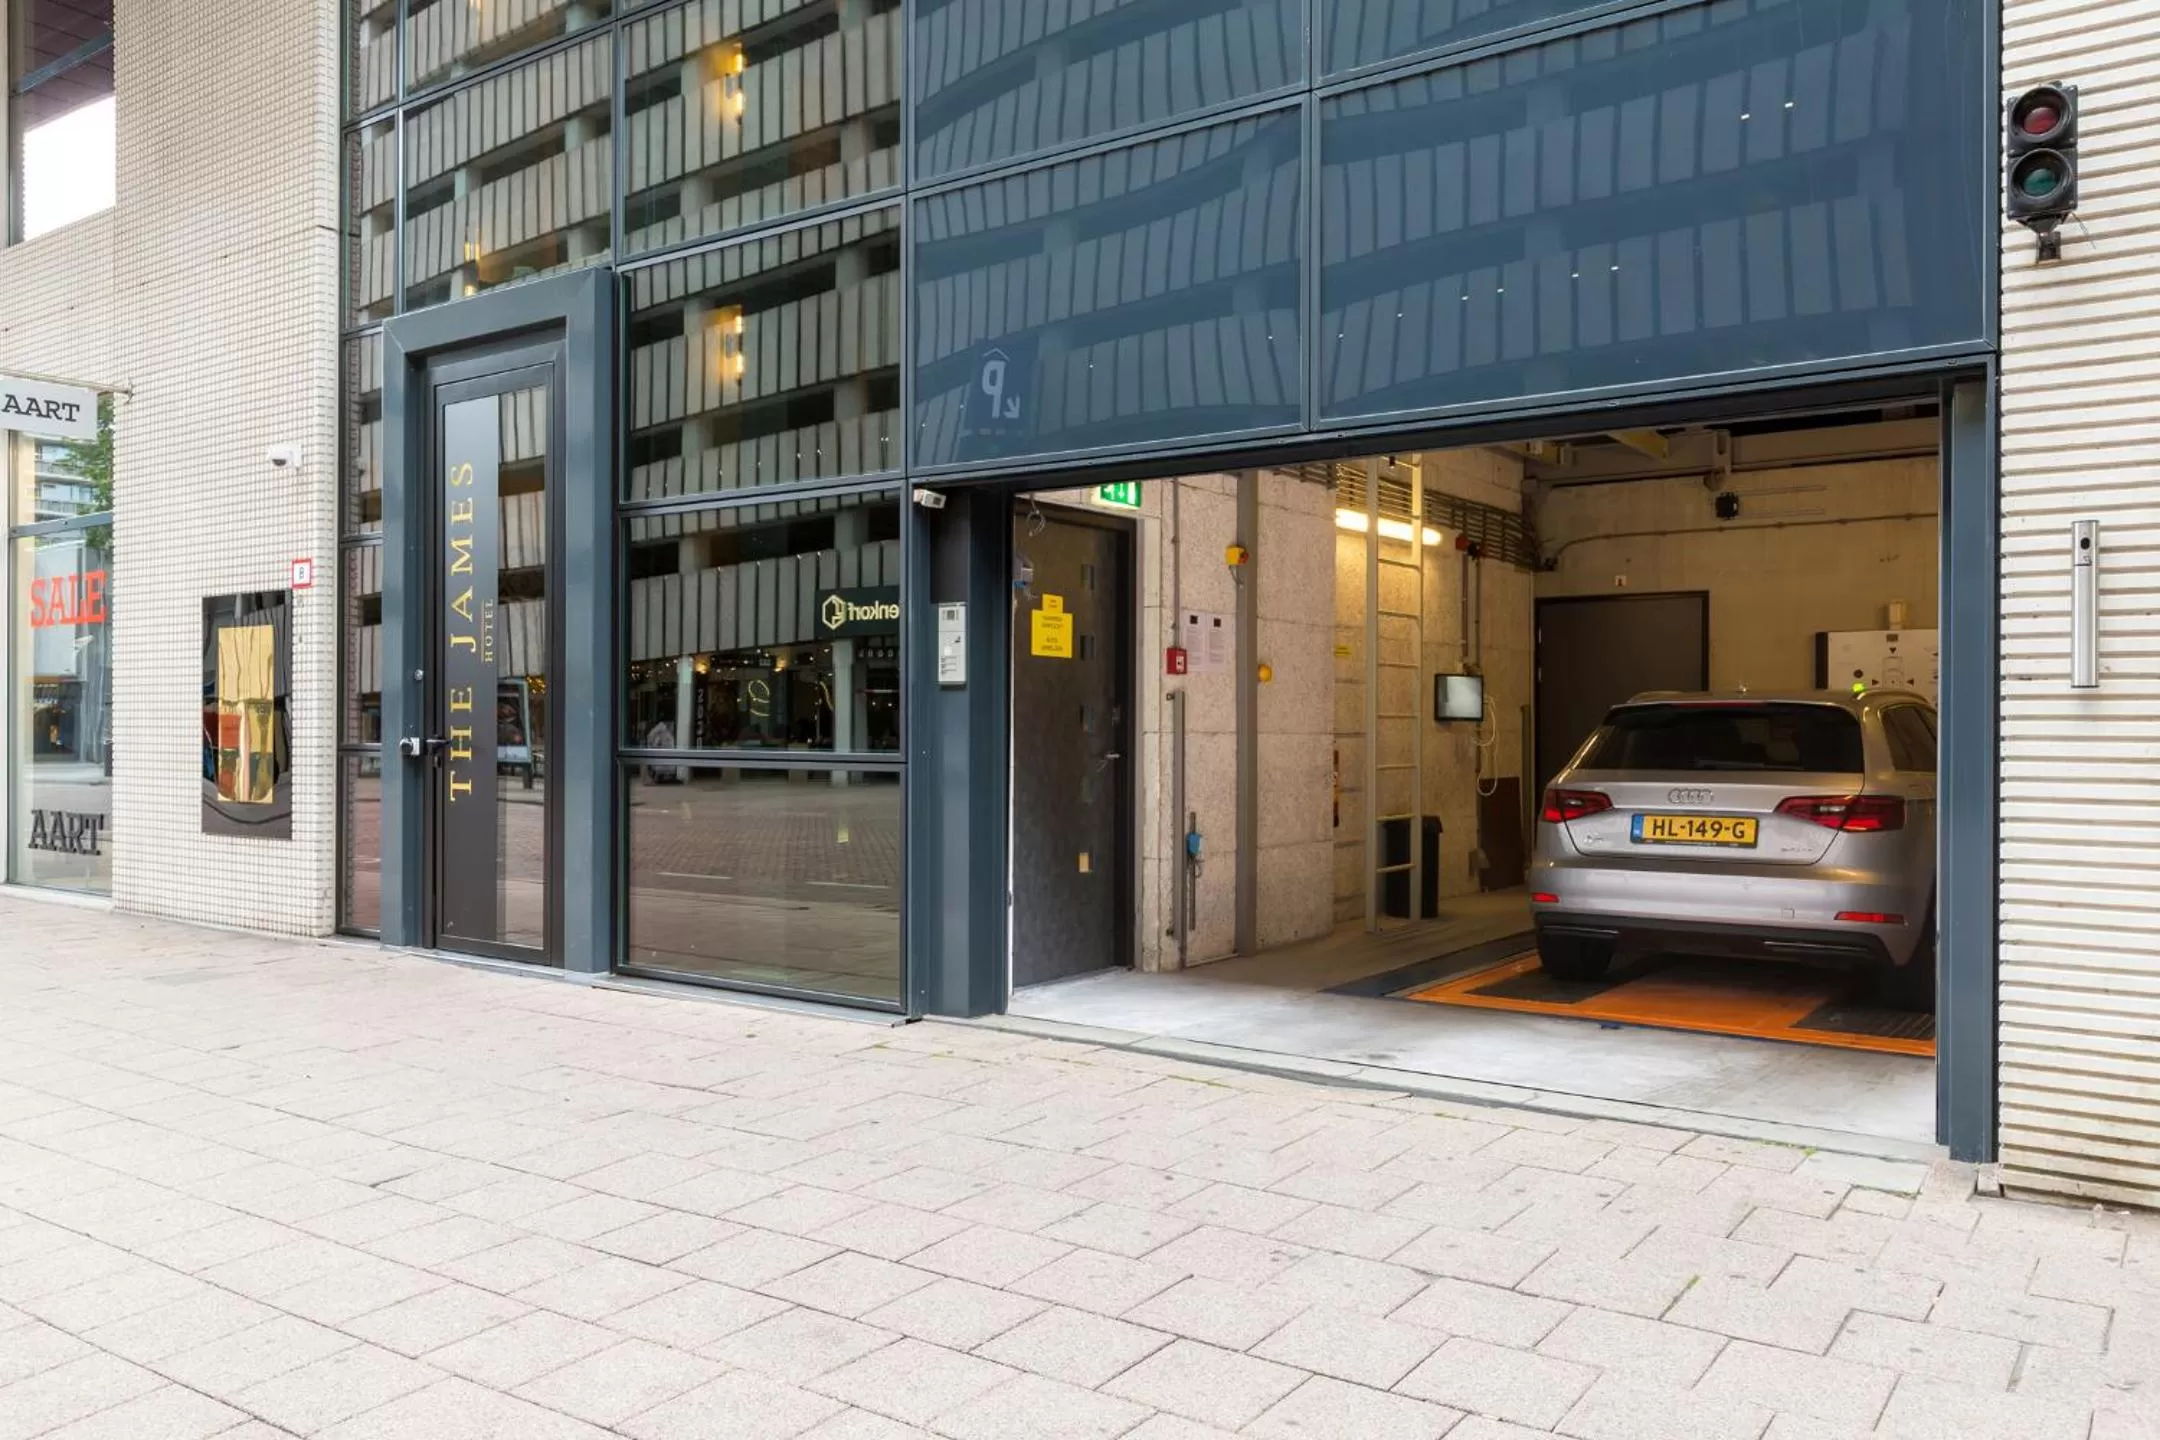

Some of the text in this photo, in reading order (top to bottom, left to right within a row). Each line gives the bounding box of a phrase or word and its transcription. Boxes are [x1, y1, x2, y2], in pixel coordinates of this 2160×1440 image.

[2, 393, 80, 422] AART
[31, 569, 108, 628] SALE
[450, 461, 476, 802] THE JAMES
[484, 599, 494, 663] HOTEL
[28, 809, 104, 856] AART
[1652, 818, 1746, 840] HL-149-G
